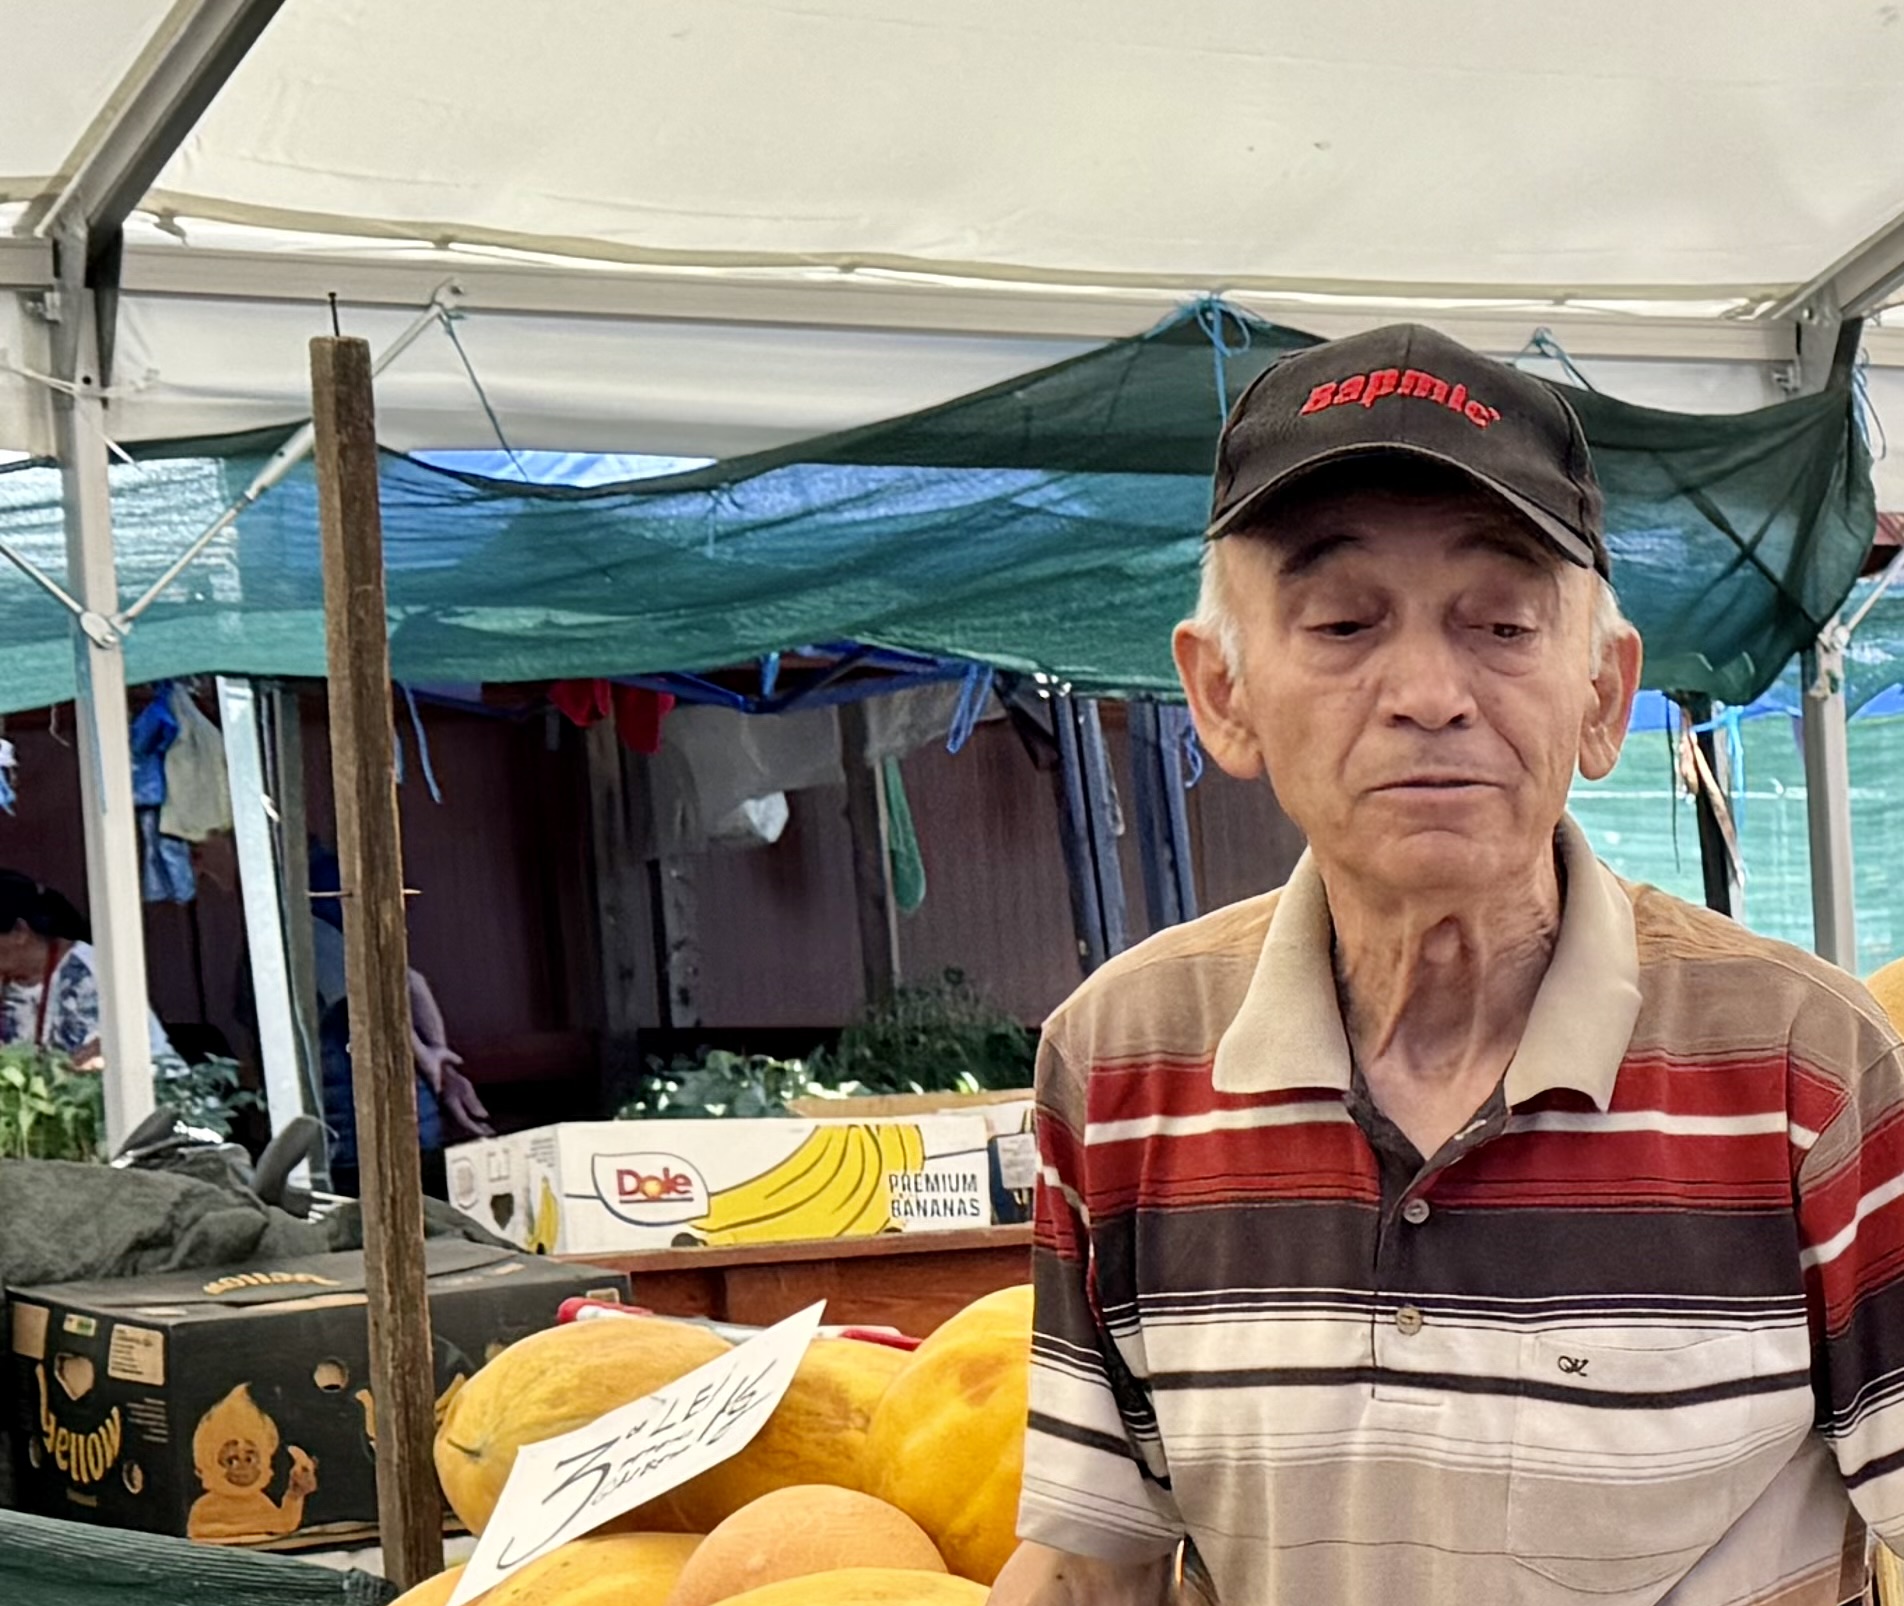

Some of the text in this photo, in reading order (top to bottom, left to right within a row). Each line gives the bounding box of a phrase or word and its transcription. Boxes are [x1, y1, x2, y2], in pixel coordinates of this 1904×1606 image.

[616, 1166, 694, 1199] Dole
[888, 1173, 978, 1194] PREMIUM
[890, 1198, 981, 1218] BANANAS
[35, 1362, 122, 1485] yellow
